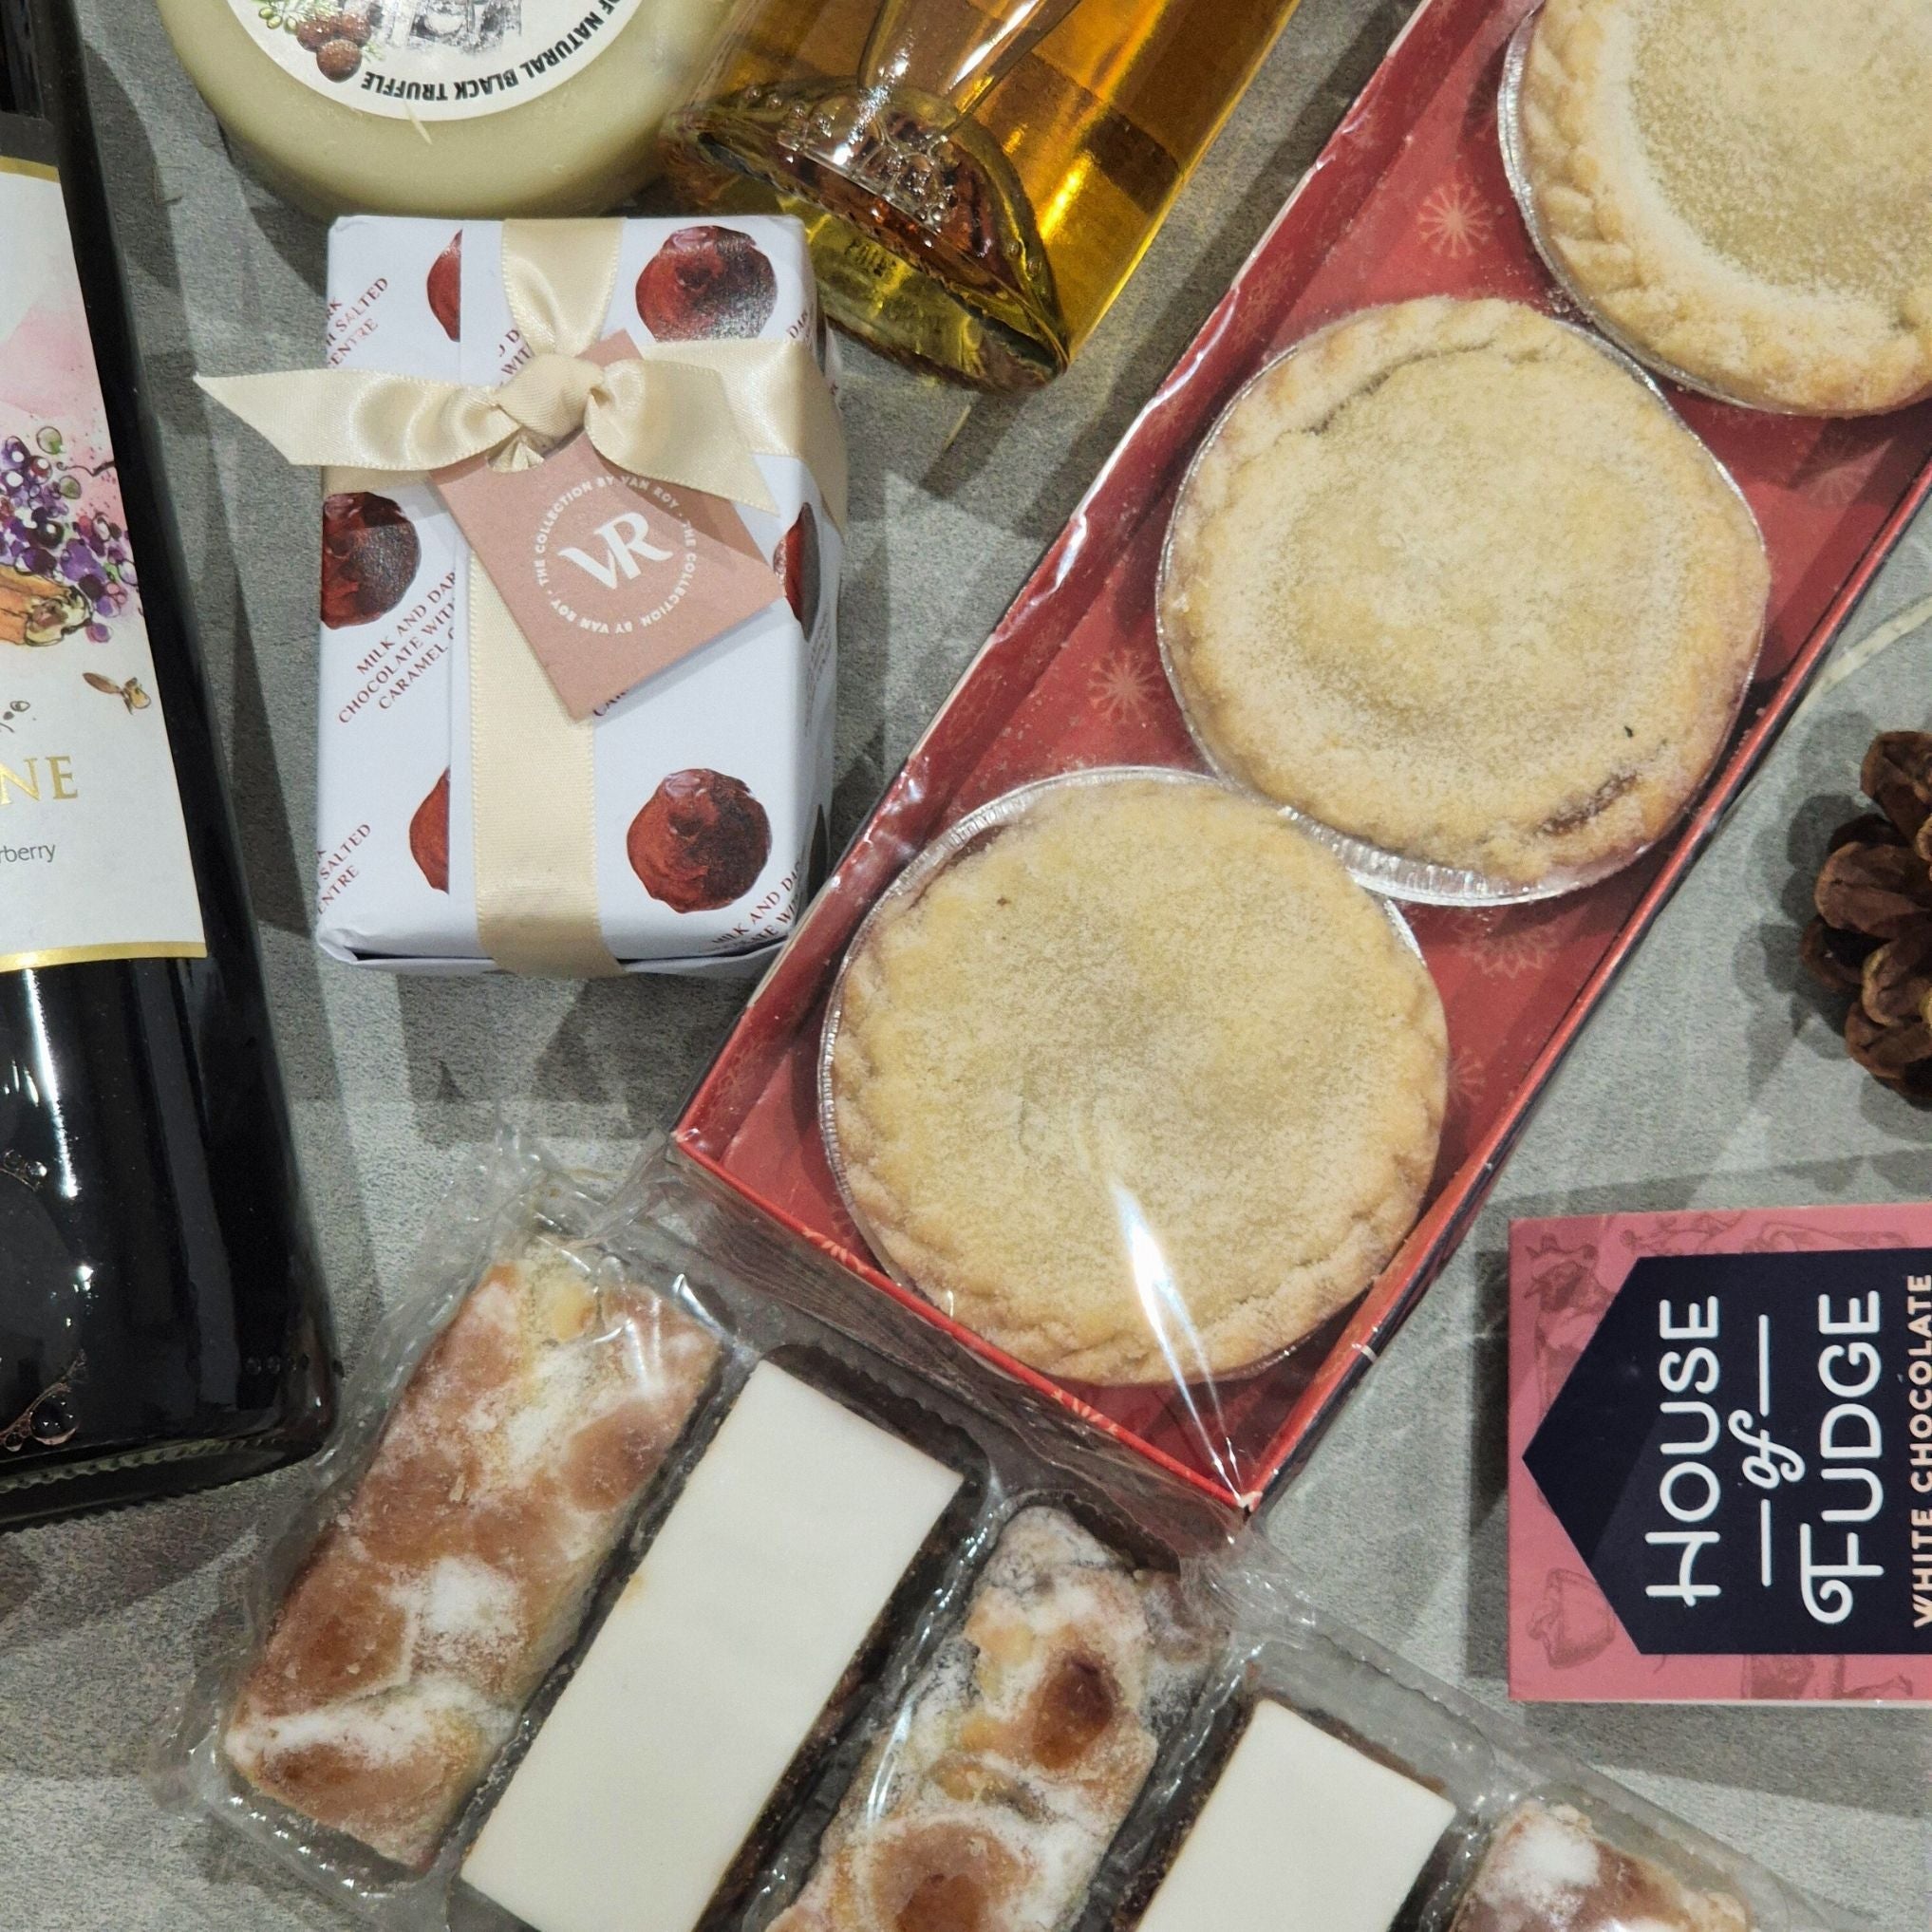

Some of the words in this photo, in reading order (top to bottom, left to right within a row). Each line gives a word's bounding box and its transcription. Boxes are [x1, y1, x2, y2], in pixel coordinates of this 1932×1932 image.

[520, 10, 605, 79] NATURAL
[361, 71, 448, 102] TRUFFLE
[454, 68, 519, 100] BLACK
[596, 476, 616, 488] BY
[620, 476, 651, 491] VAN
[653, 486, 680, 509] ROY
[535, 481, 593, 554] COLLECTION
[682, 519, 697, 548] THE
[534, 559, 551, 587] THE
[557, 512, 674, 590] VR
[550, 599, 577, 623] ROY
[640, 553, 698, 628] COLLECTION
[356, 635, 396, 675] MILK
[396, 604, 428, 638] AND
[579, 618, 610, 634] VAN
[615, 620, 634, 634] BY
[338, 636, 424, 723] CHOCOLATE
[378, 643, 449, 710] CARAMEL
[319, 823, 371, 881] SALTED
[748, 891, 781, 926] AND
[1906, 1273, 1932, 1492] CHOCOLATE
[1645, 1295, 1721, 1606] HOUSE
[1727, 1409, 1806, 1490] of
[1799, 1290, 1885, 1625] FUDGE
[1910, 1508, 1932, 1628] WHITE
